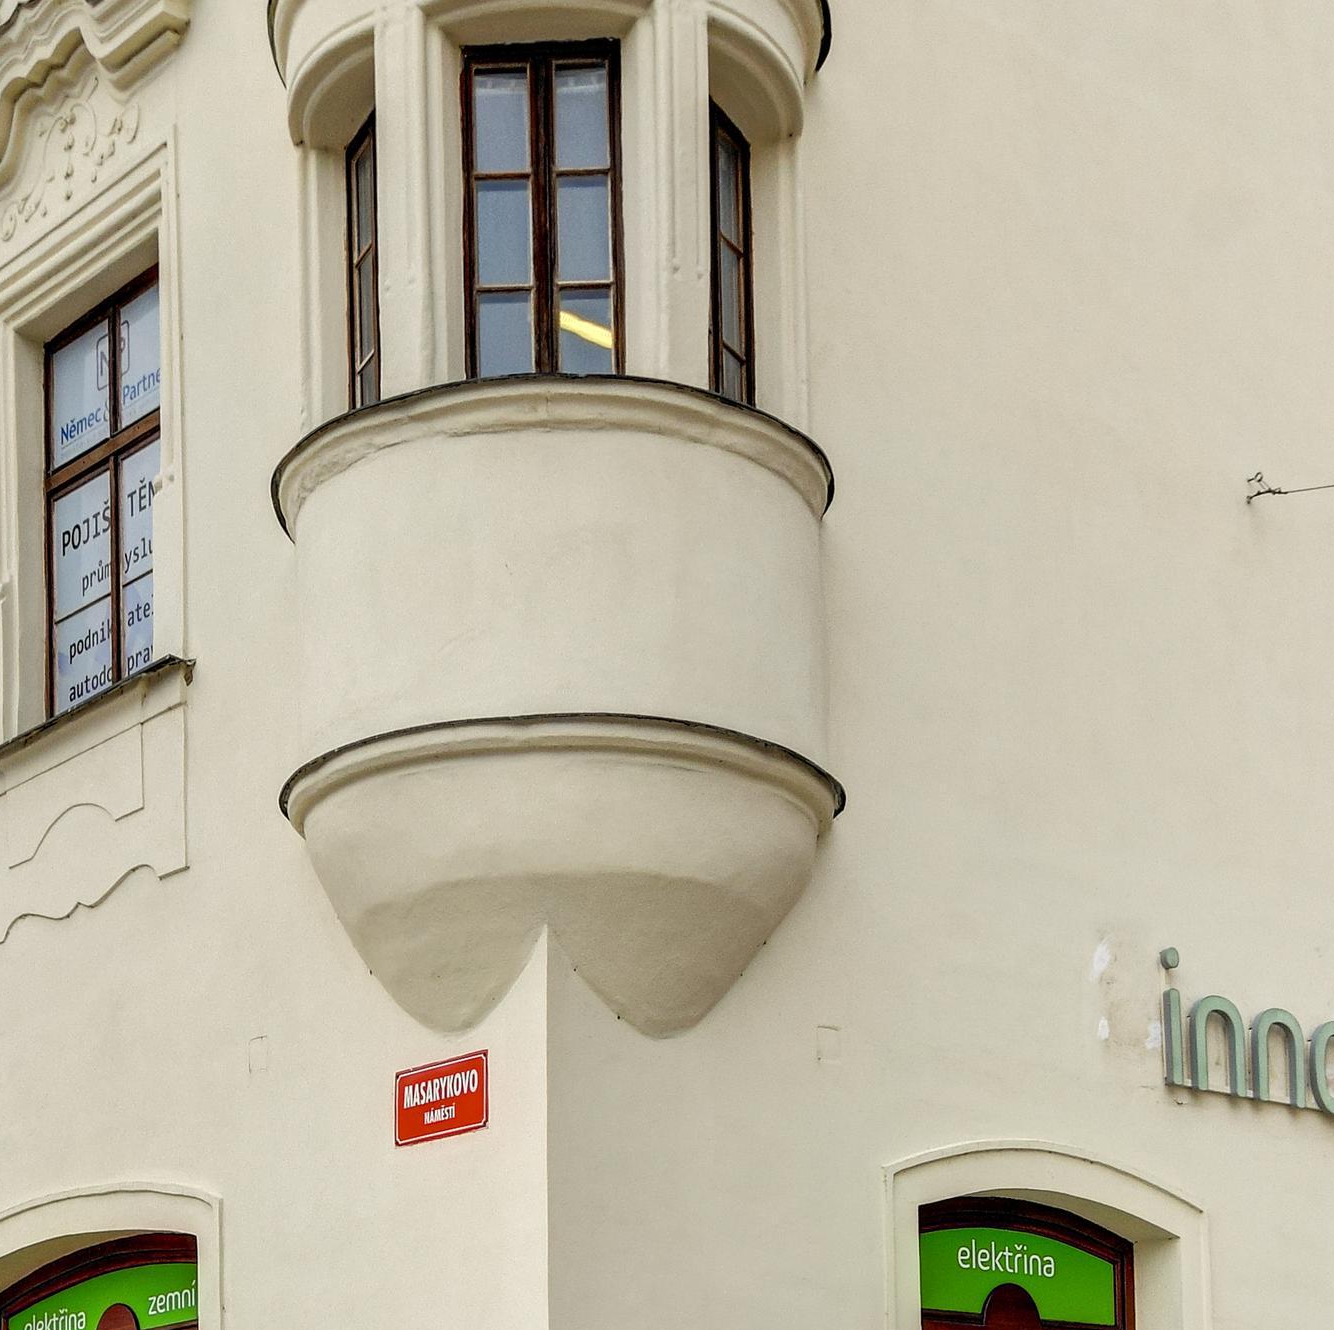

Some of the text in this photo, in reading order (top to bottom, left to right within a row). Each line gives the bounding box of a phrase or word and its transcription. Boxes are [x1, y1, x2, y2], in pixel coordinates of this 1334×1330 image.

[61, 406, 101, 445] Němec
[403, 1068, 479, 1110] MASARYKOVO
[424, 1102, 456, 1125] NÁMĚSTÍ
[956, 1238, 1056, 1279] elektřina
[147, 1279, 196, 1316] zemní
